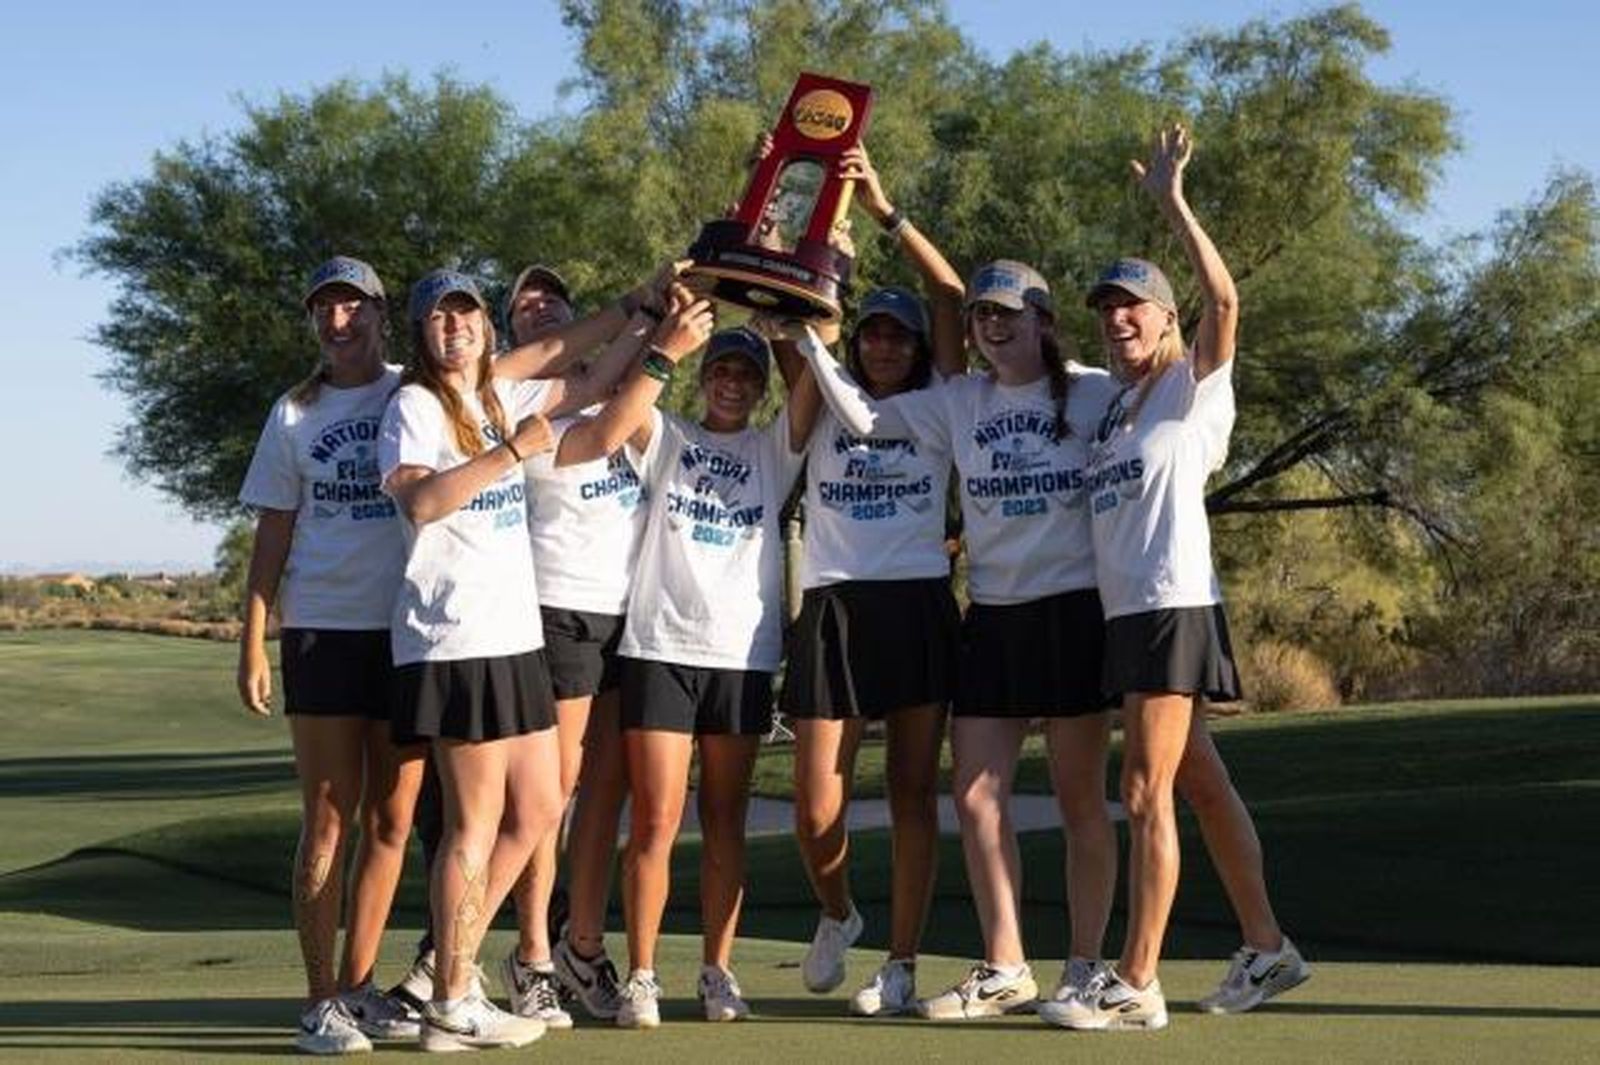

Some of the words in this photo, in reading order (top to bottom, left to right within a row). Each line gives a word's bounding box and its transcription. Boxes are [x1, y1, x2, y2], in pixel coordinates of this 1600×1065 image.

[819, 476, 932, 502] CHAMPIONS
[967, 469, 1084, 497] CHAMPIONS
[852, 500, 897, 520] 2023
[1001, 497, 1047, 517] 2023
